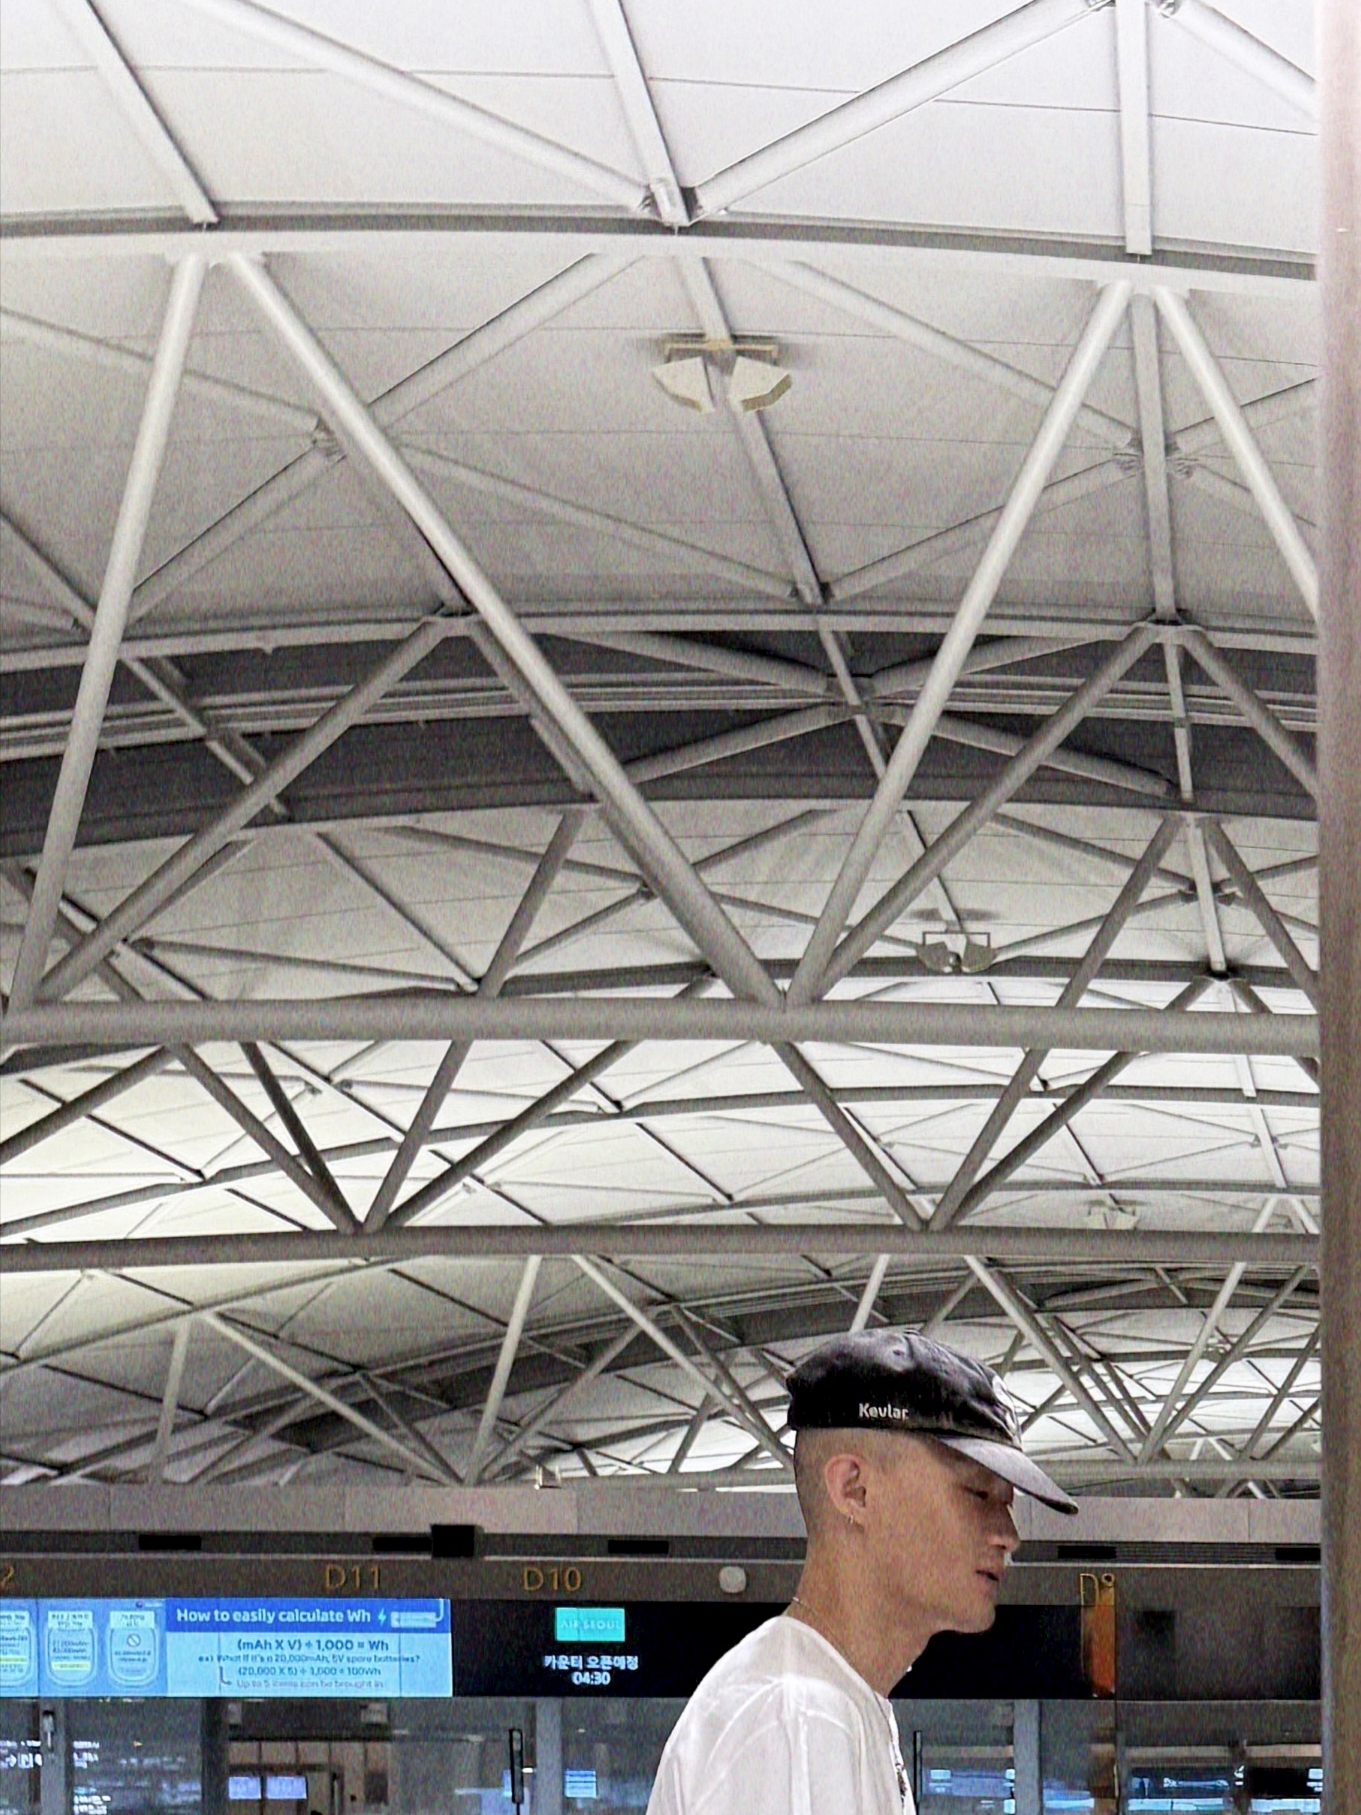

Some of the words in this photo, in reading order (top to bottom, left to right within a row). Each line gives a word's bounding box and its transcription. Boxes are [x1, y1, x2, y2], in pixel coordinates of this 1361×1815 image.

[859, 1402, 909, 1420] Kevlar
[325, 1565, 381, 1589] D11
[523, 1566, 582, 1591] D10
[177, 1608, 210, 1622] How
[214, 1608, 230, 1622] to
[233, 1608, 275, 1625] easily
[278, 1608, 344, 1623] calculate
[346, 1608, 371, 1623] Wh
[237, 1639, 272, 1651] (mAh
[275, 1640, 284, 1650] X
[287, 1639, 302, 1651] V)
[316, 1639, 354, 1652] 1,000
[368, 1640, 389, 1651] Wh
[571, 1671, 611, 1685] 04:30
